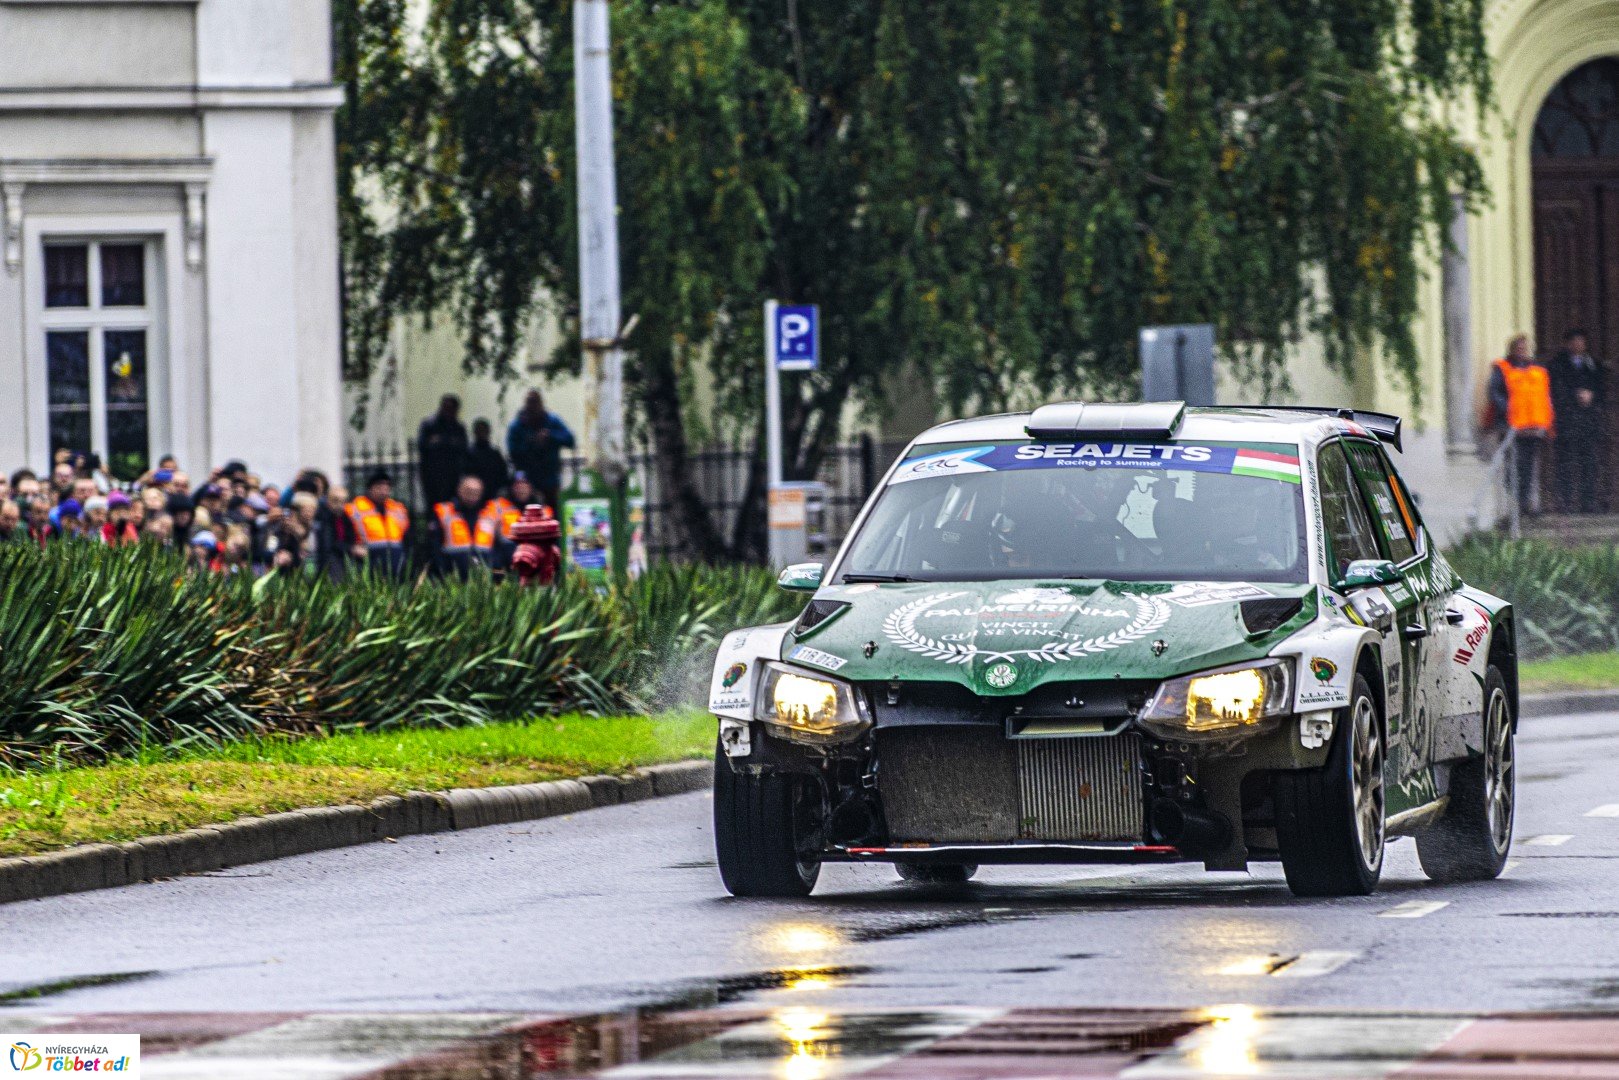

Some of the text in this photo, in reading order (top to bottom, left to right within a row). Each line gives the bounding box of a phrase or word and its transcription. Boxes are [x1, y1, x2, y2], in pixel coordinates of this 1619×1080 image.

[780, 313, 810, 352] P
[1014, 443, 1212, 462] SEAJETS
[1056, 458, 1097, 467] Racing
[924, 604, 1131, 618] PALMEIRINHA
[981, 621, 1054, 629] VINCIT
[941, 628, 1085, 641] QUI SE VINCIT
[1465, 622, 1489, 651] Rally
